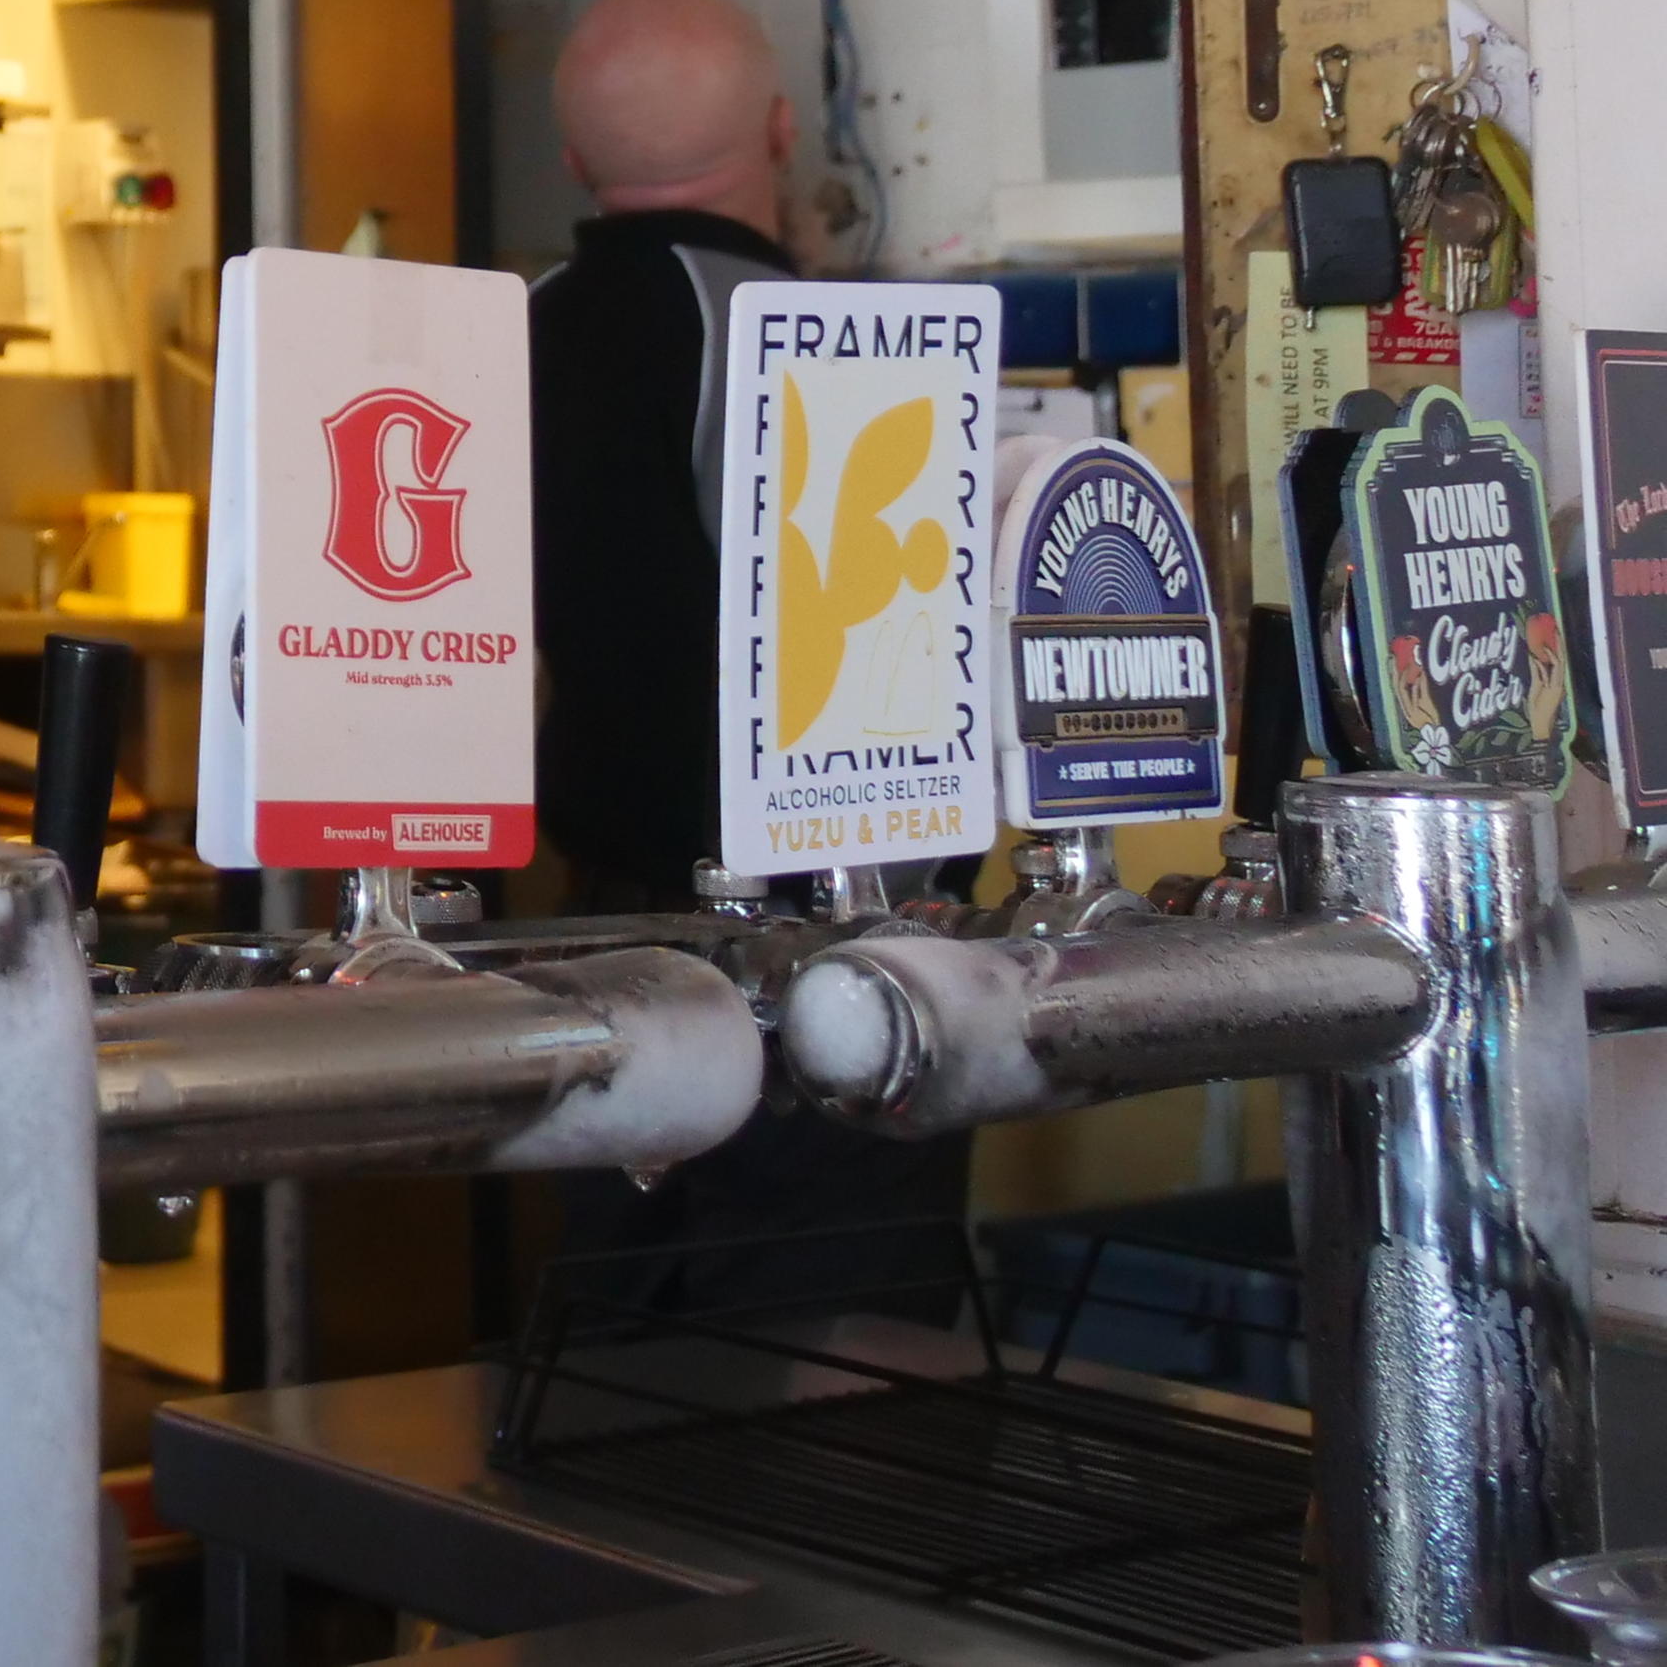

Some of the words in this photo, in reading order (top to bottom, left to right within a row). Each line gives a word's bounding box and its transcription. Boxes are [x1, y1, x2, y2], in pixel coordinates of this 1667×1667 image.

[759, 313, 983, 375] FRAMER
[1281, 313, 1298, 341] TO
[1281, 344, 1299, 395] NEED
[1313, 346, 1329, 389] 9PM
[1312, 391, 1329, 419] AT
[1403, 481, 1511, 545] YOUNG
[1035, 481, 1099, 598] YOUNG
[1099, 477, 1189, 600] HENRYS
[1403, 543, 1527, 610] HENRYS
[278, 624, 415, 660] GLADDY
[421, 630, 518, 664] CRISP
[1022, 635, 1211, 703] NEWTOWNER
[1427, 611, 1517, 685] Cloudy
[345, 671, 369, 685] Mid
[371, 672, 423, 688] strength
[1452, 667, 1524, 729] Cider
[765, 782, 877, 812] ALCOHOLIC
[883, 774, 962, 802] SELTZER
[1068, 761, 1110, 782] SERVE
[1110, 760, 1137, 780] THE
[1139, 756, 1187, 778] PEOPLE
[323, 826, 371, 840] Brewed
[372, 826, 388, 842] by
[399, 822, 485, 843] ALEHOUSE
[766, 815, 845, 854] YUZU
[857, 812, 874, 845] &
[885, 804, 963, 843] PEAR
